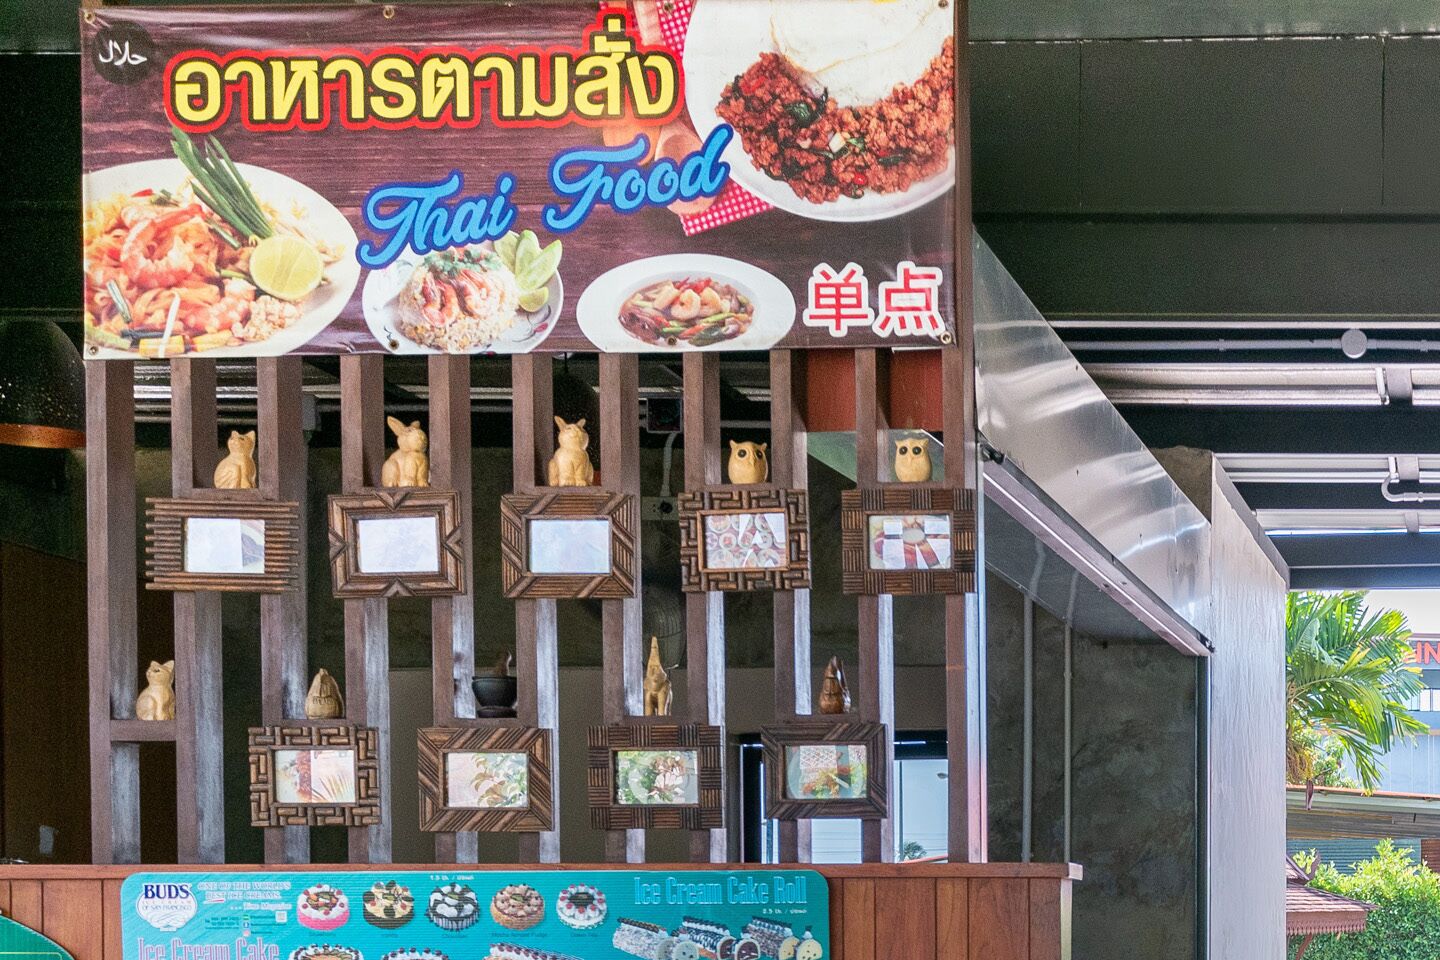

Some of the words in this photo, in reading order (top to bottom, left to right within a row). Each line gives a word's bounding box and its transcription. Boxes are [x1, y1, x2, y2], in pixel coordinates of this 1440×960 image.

[172, 17, 679, 124] อาหารตามสั่ง
[358, 171, 516, 270] Thai
[542, 124, 734, 234] Food
[805, 263, 943, 335] 单点
[634, 877, 661, 904] Ice
[665, 877, 723, 904] Cream
[727, 876, 769, 904] Cake
[773, 876, 807, 904] Roll
